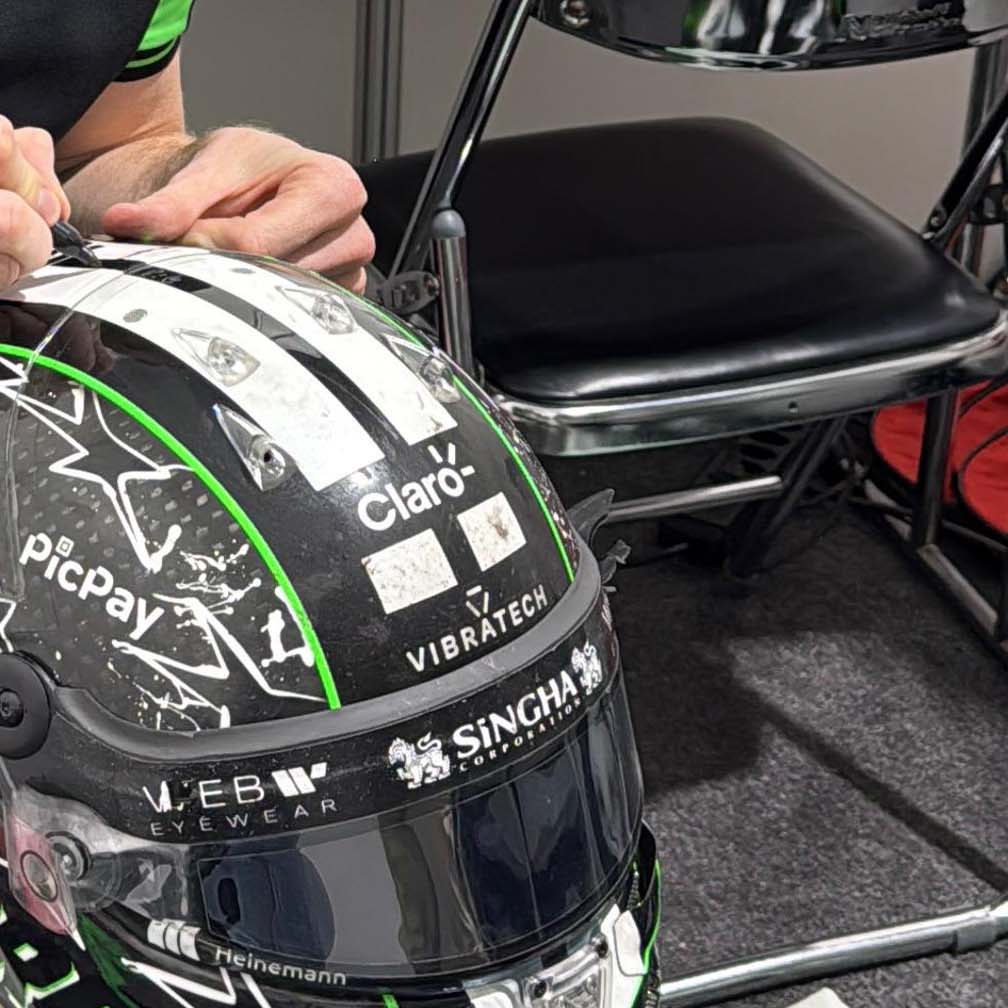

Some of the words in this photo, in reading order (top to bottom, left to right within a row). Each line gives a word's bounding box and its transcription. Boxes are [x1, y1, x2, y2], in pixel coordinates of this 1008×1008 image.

[18, 532, 165, 641] PicPay
[406, 584, 548, 673] VIBRATECH
[459, 697, 581, 772] CORPORATION
[150, 799, 338, 837] EYEWEAR
[215, 945, 347, 986] Heinemann
